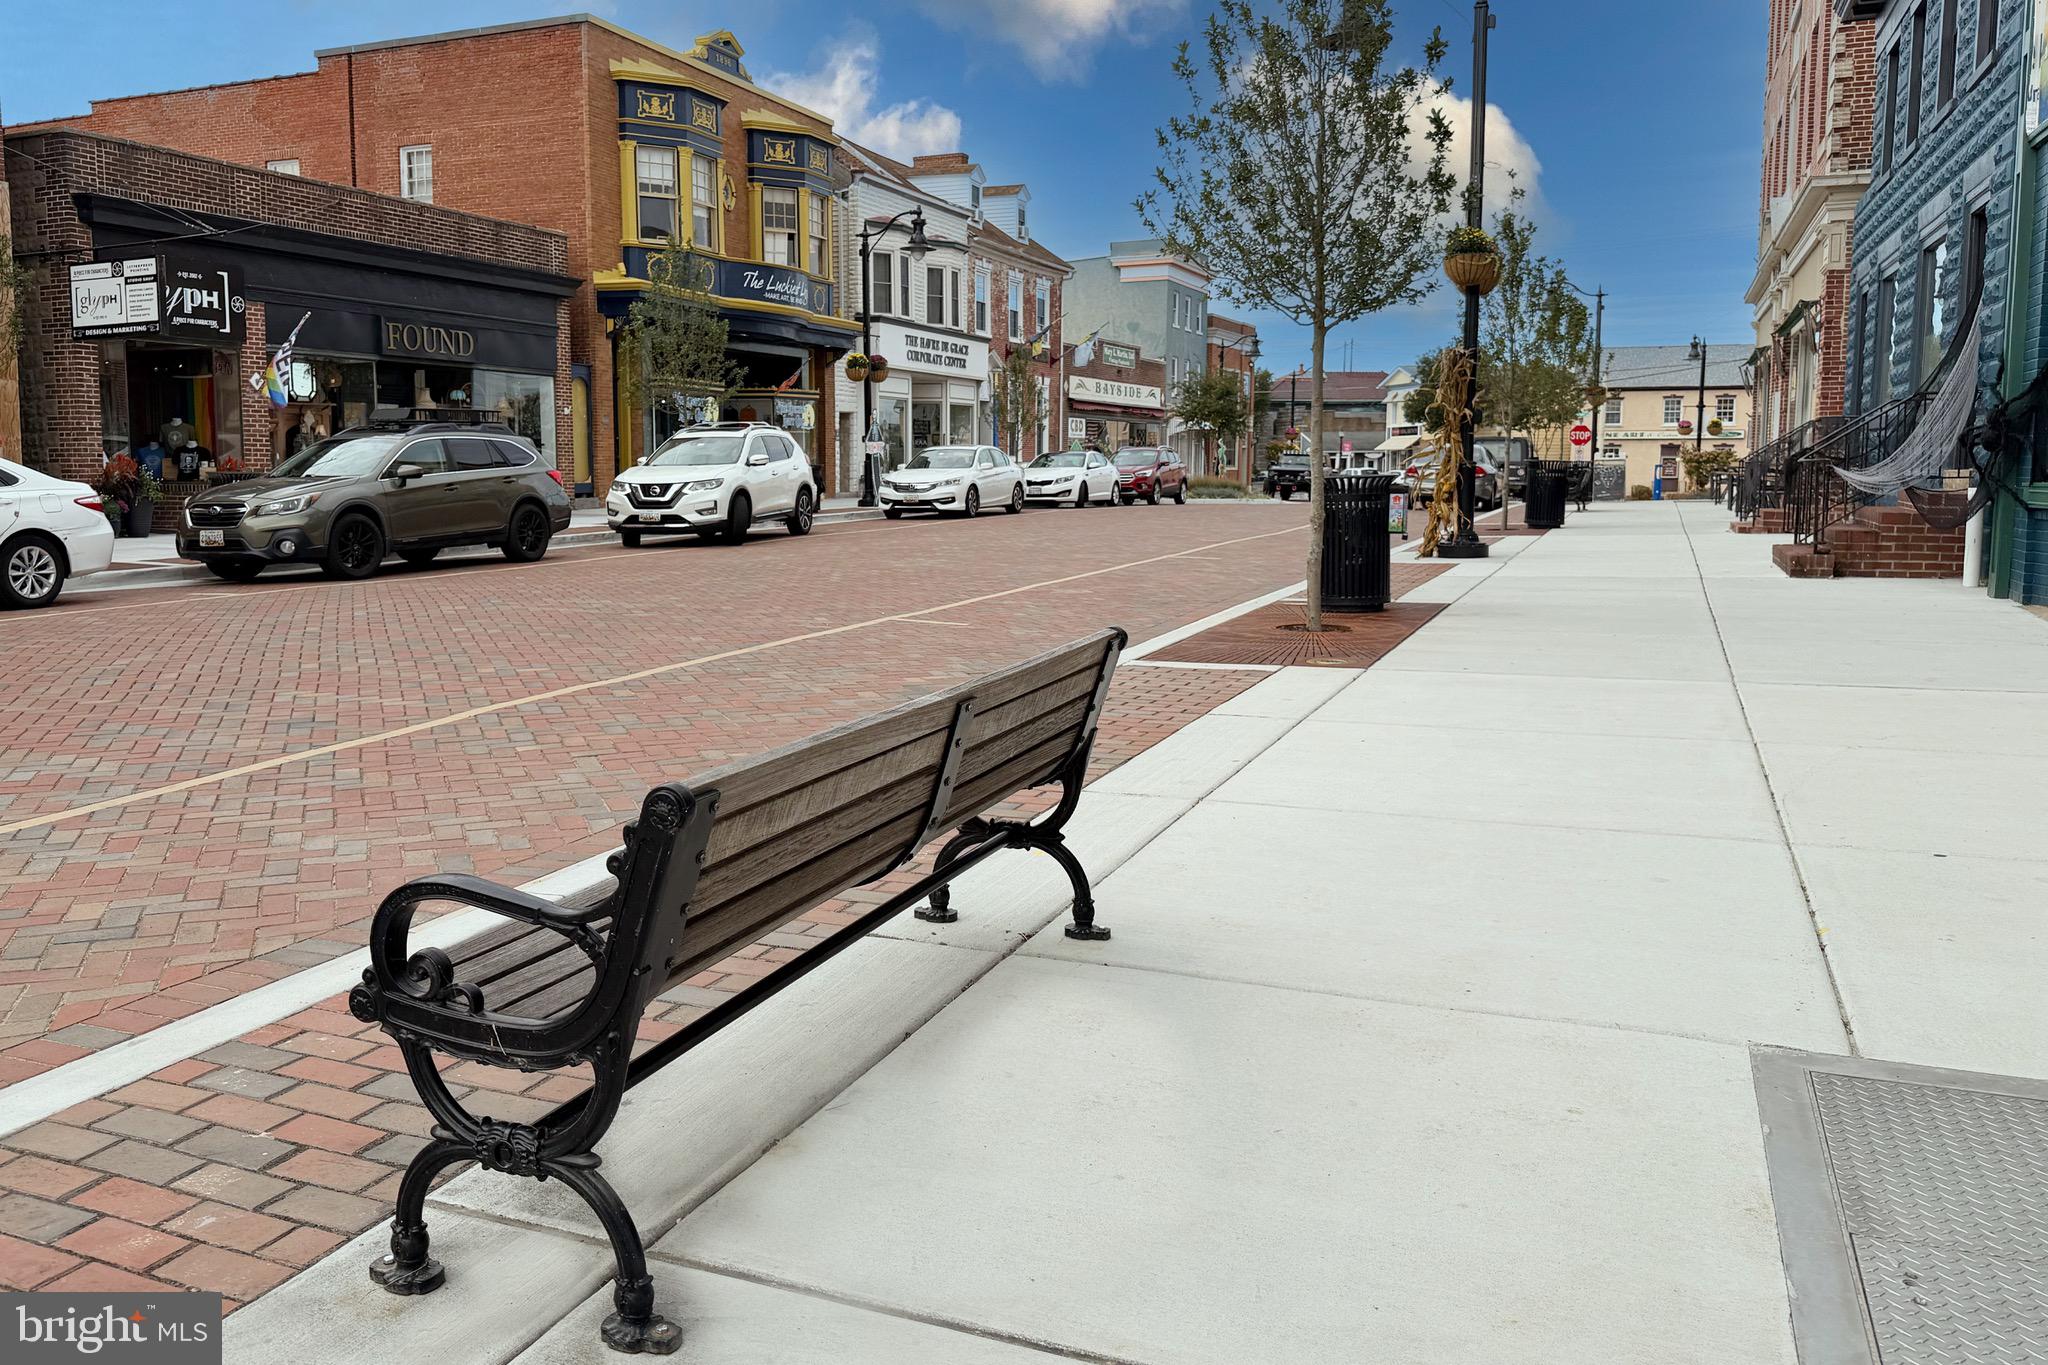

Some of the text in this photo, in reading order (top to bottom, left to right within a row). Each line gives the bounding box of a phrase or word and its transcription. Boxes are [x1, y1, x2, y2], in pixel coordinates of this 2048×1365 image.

[743, 270, 764, 289] The
[766, 274, 801, 296] Luckiest
[85, 328, 107, 336] DESIGN
[113, 325, 147, 335] MARKETING
[386, 322, 474, 357] FOUND
[904, 334, 969, 356] THE HAVRE DE GRACE
[906, 349, 967, 369] CORPORATE CENTER
[1095, 381, 1141, 399] BAYSIDE
[1070, 418, 1083, 433] CBD
[1570, 430, 1591, 441] STOP
